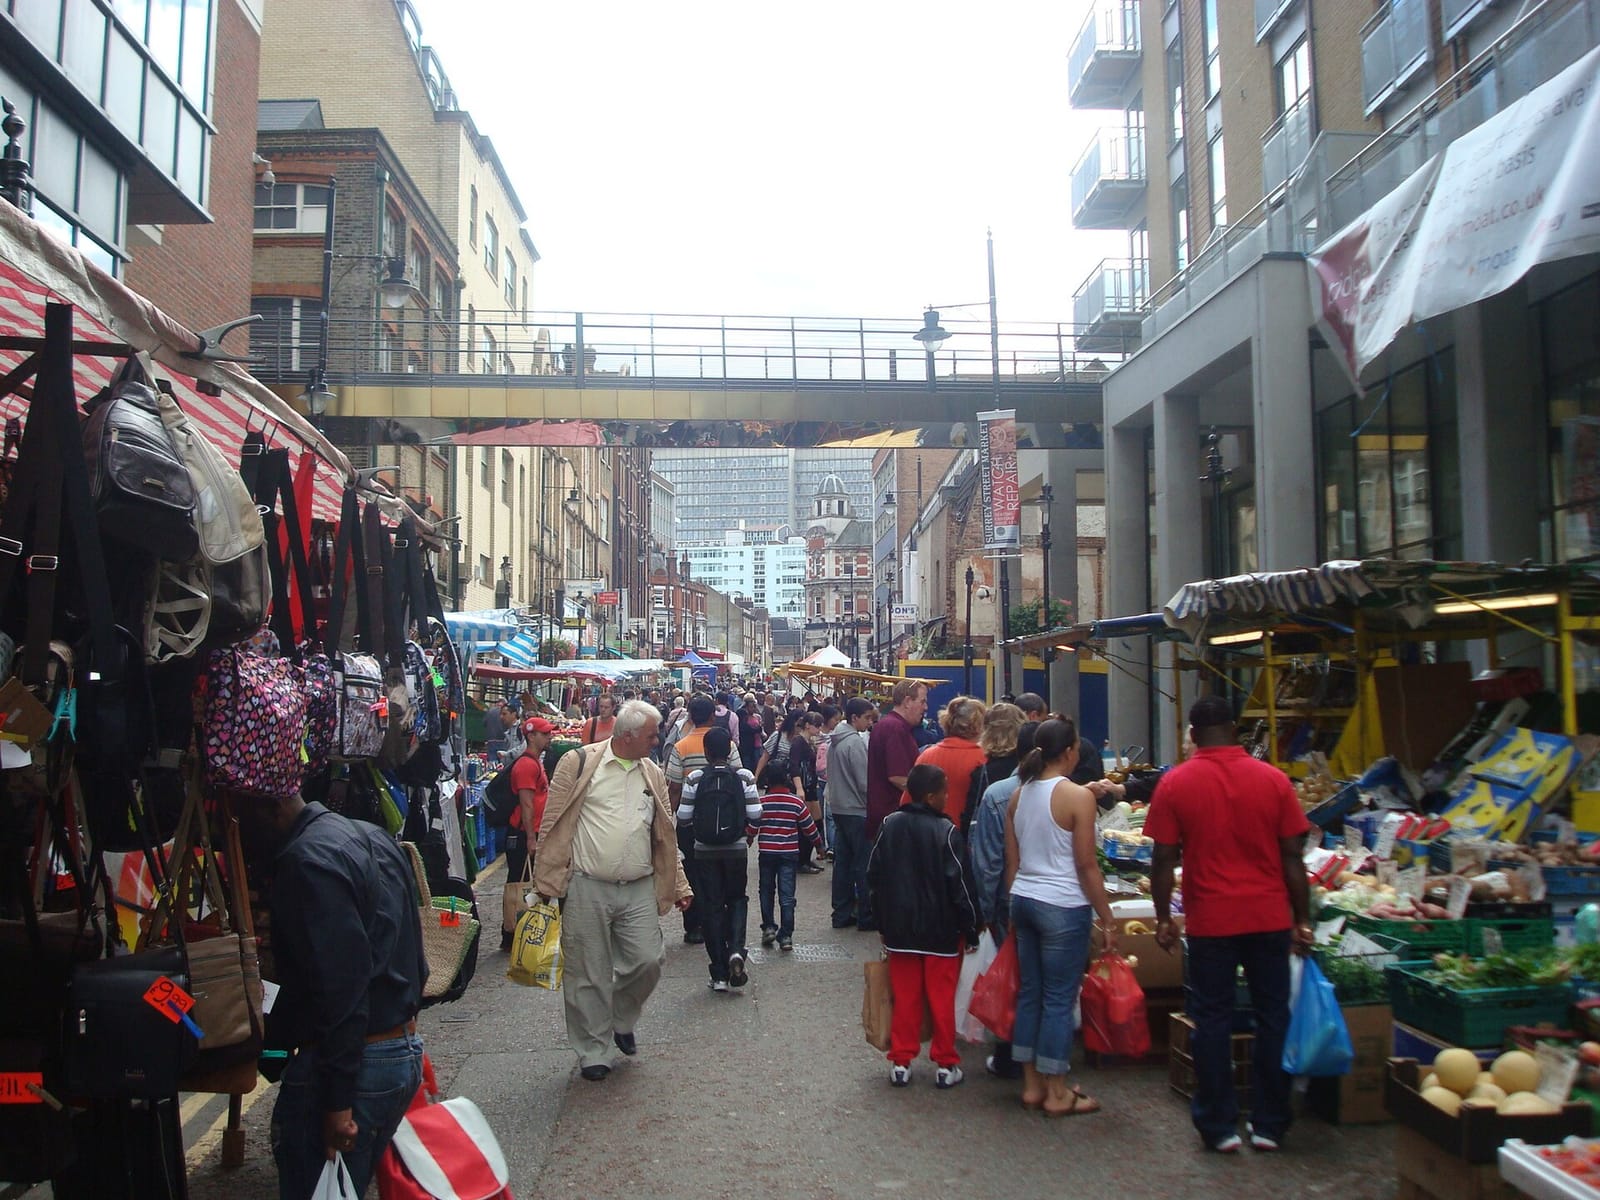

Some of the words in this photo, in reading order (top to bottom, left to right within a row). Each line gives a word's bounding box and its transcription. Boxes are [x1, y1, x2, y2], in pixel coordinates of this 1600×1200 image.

[980, 422, 990, 463] MARKET
[981, 464, 992, 503] STREET
[992, 456, 1005, 511] WATCH
[983, 506, 994, 543] SURREY
